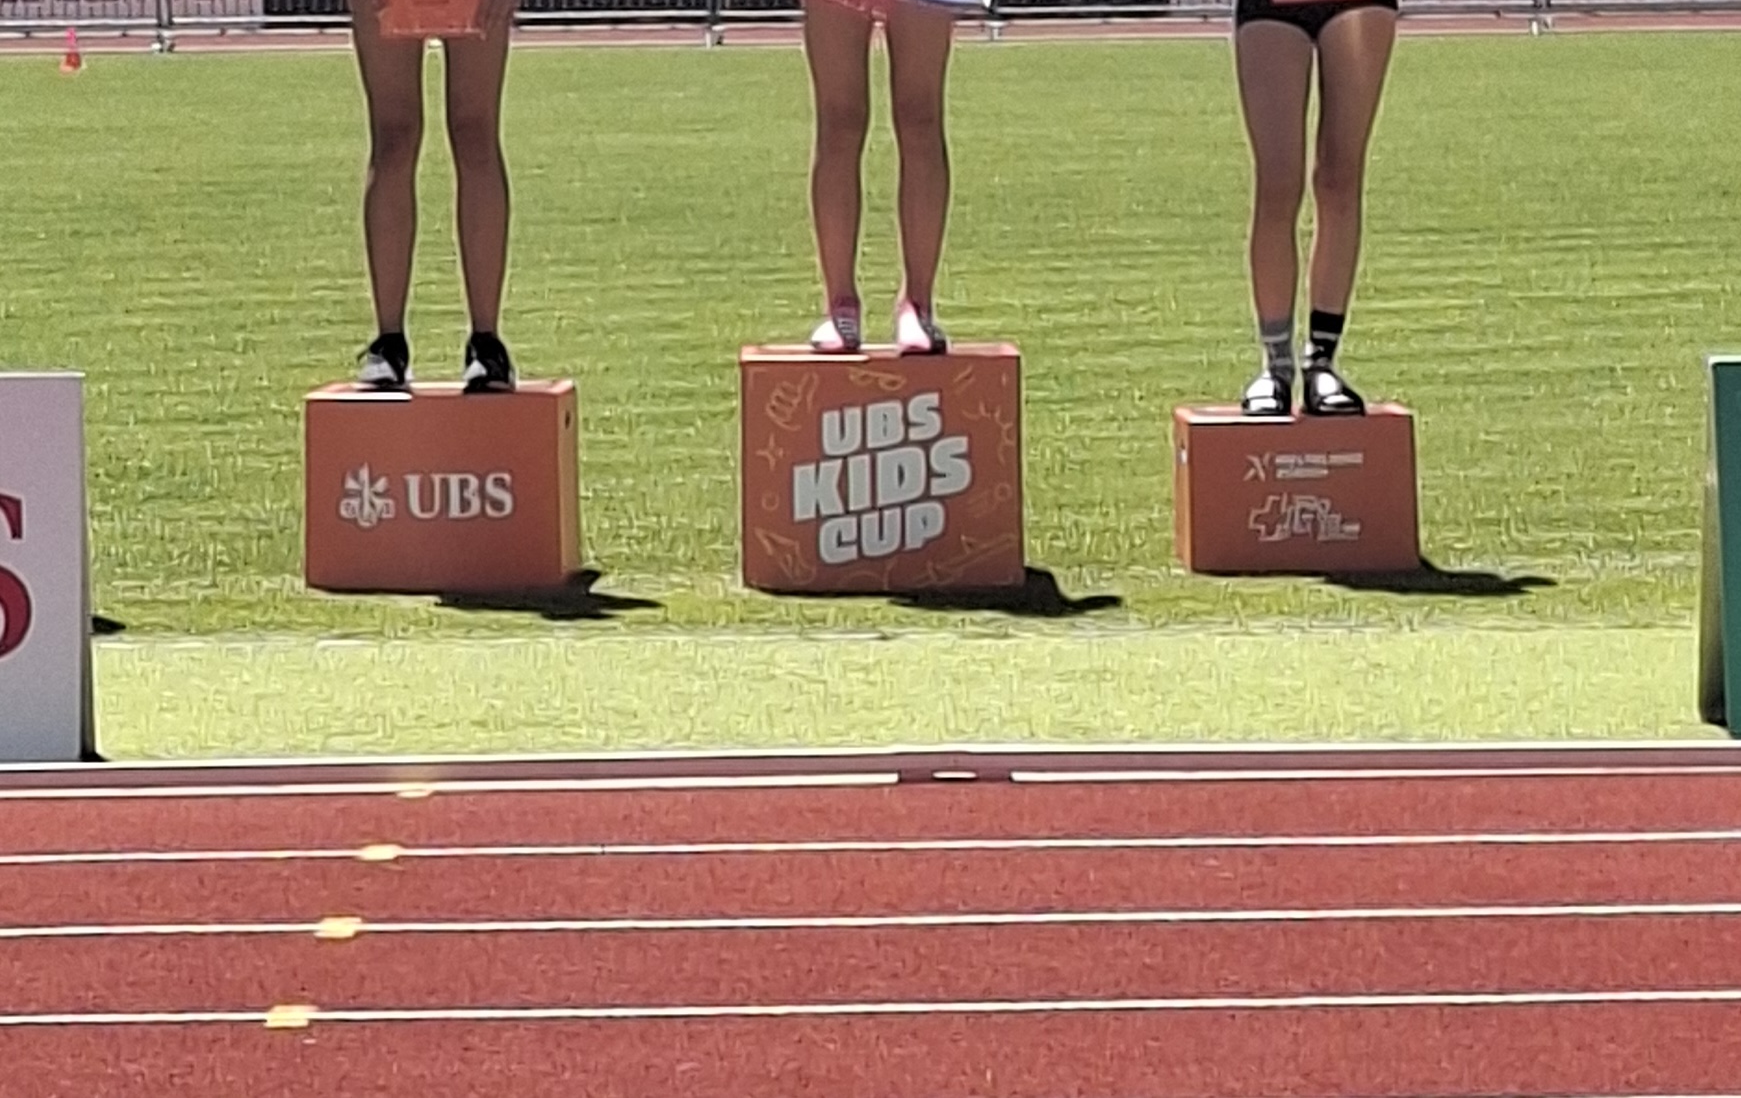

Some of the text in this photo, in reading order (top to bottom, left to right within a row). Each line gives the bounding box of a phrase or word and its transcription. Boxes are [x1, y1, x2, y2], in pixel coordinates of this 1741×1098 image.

[822, 392, 942, 456] UBS
[404, 472, 514, 520] UBS
[793, 436, 972, 522] KIDS
[819, 501, 945, 564] CUP
